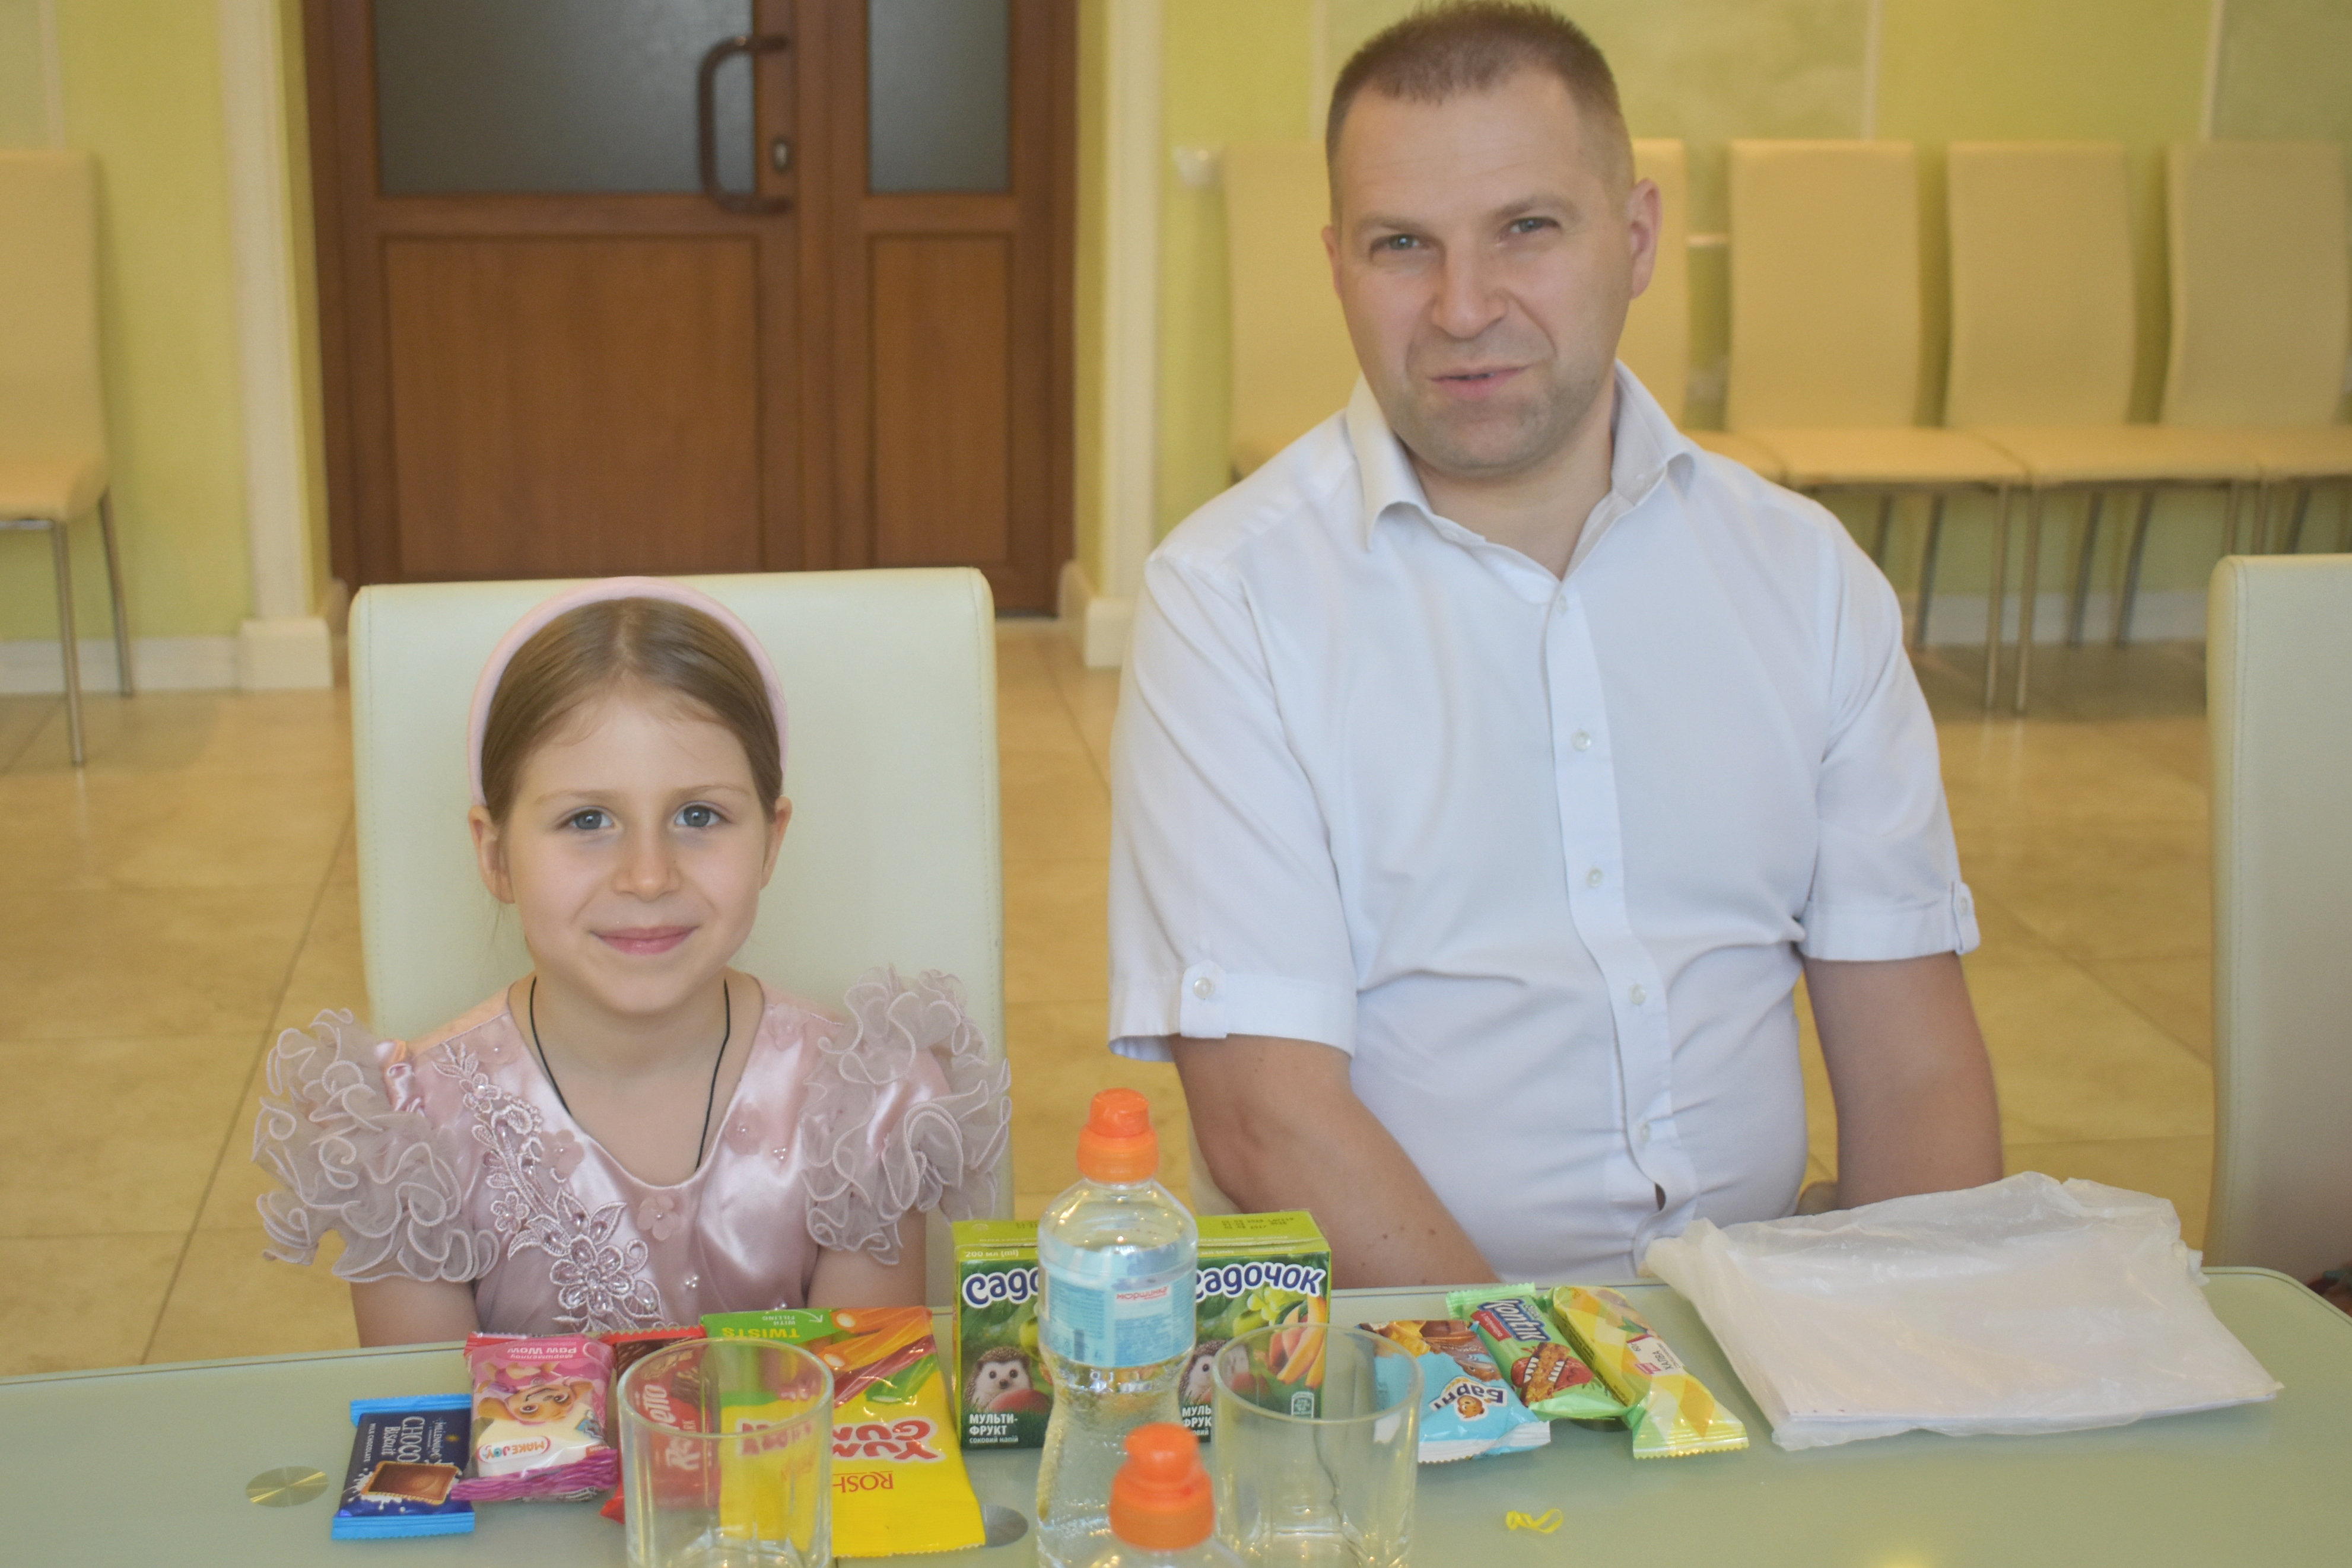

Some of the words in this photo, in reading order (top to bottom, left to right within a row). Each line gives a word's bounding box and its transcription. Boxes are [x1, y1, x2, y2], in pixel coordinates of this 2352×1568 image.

[722, 1327, 800, 1338] TWISTS
[1652, 1350, 1674, 1370] ХАЛВА
[969, 1413, 1018, 1424] МУЛЬТИ-
[1182, 1405, 1212, 1417] МУЛЬ
[1183, 1416, 1212, 1427] ФРУК
[432, 1421, 446, 1456] MILLENNIUM
[969, 1425, 1007, 1436] ФРУКТ
[397, 1416, 425, 1462] CHOCO
[363, 1435, 374, 1463] CHOCOLATE
[833, 1471, 894, 1493] ROSH
